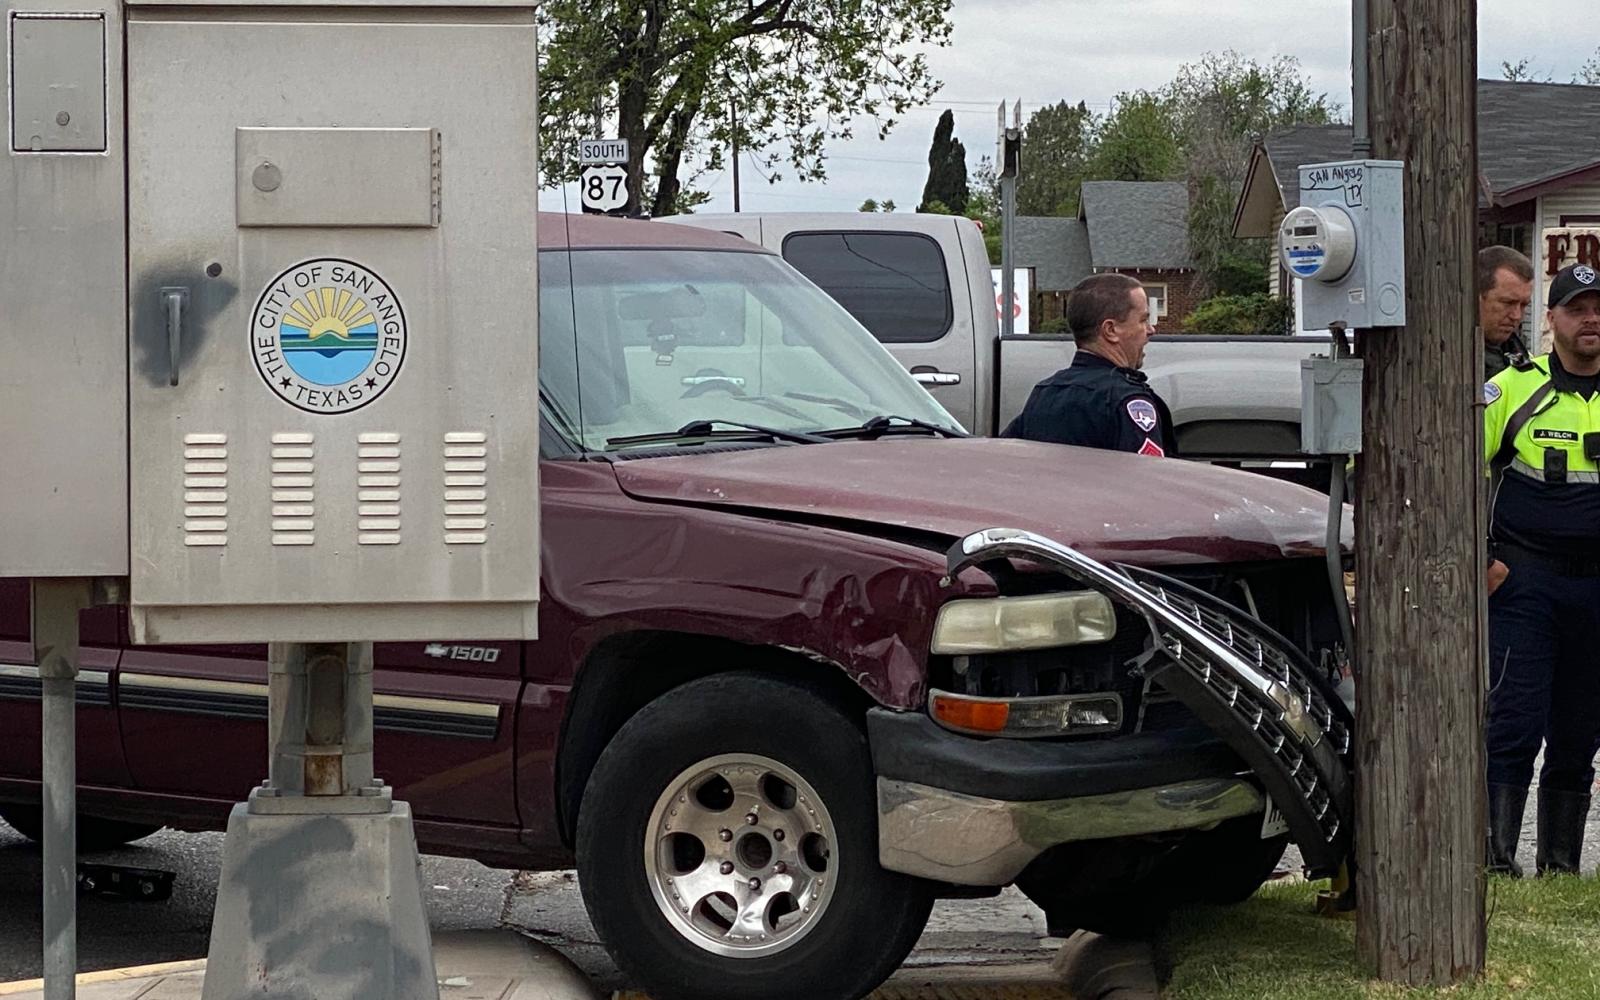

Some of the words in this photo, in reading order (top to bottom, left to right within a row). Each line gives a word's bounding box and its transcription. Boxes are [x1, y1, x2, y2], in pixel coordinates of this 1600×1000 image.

[584, 144, 625, 159] SOUTH
[588, 175, 623, 200] 87
[1308, 168, 1329, 189] SAN
[294, 267, 322, 287] OF
[331, 267, 374, 294] SAN
[259, 282, 291, 329] CITY
[371, 294, 400, 377] ANGELO
[258, 335, 284, 378] THE
[296, 384, 363, 407] TEXAS
[1547, 431, 1573, 439] WELCH
[450, 646, 500, 663] 1500
